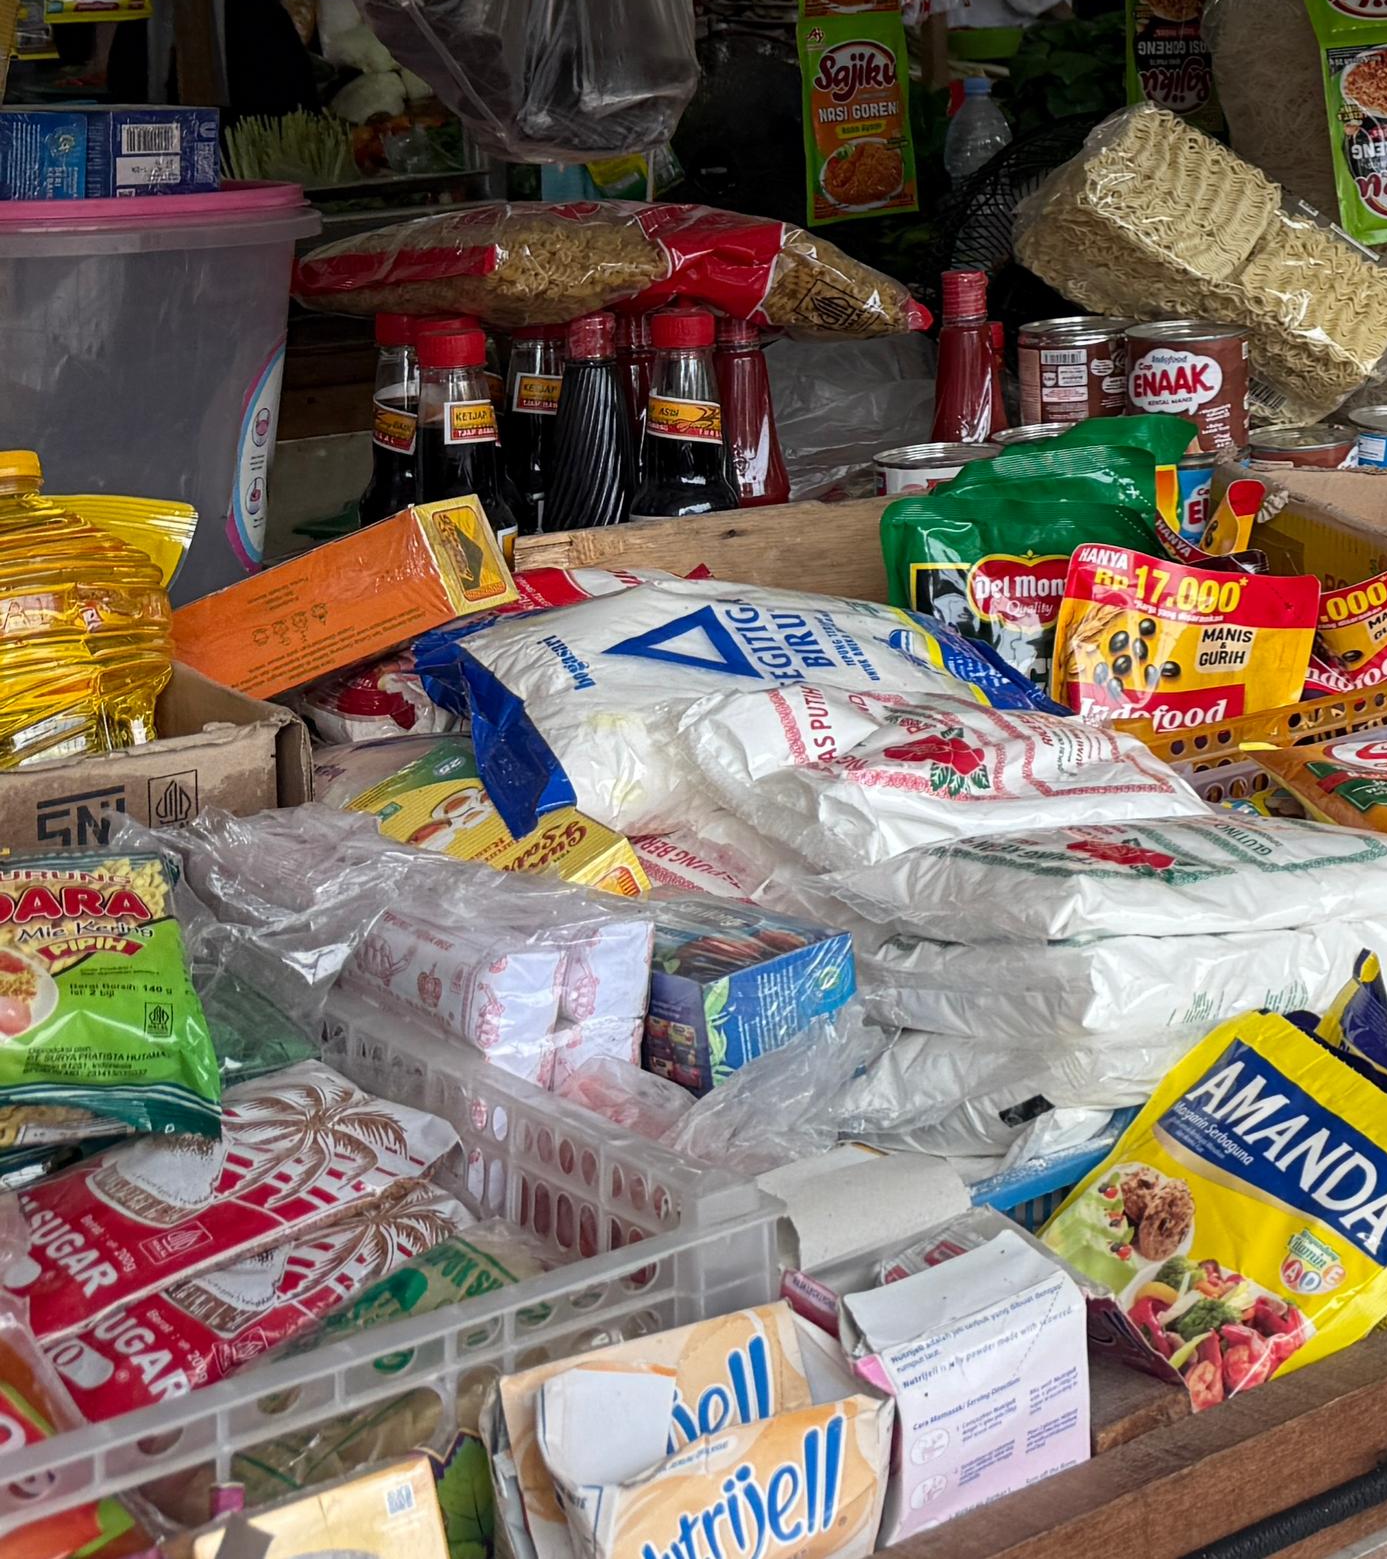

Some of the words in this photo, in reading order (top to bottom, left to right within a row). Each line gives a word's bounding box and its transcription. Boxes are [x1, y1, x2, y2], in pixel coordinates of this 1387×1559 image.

[813, 51, 898, 103] Sajiku
[818, 104, 849, 123] NASI
[1133, 362, 1214, 399] ENAAK
[455, 411, 488, 423] KETJAP
[1155, 518, 1193, 558] HANYA
[1077, 545, 1129, 571] HANYA
[974, 576, 1011, 599] Del
[1014, 574, 1067, 598] Mon
[1093, 566, 1130, 593] Rp
[1005, 599, 1054, 618] Quality
[780, 610, 836, 671] BIRU
[1201, 628, 1254, 644] MANIS
[1198, 648, 1247, 667] GURIH
[801, 685, 829, 728] PUTIH
[17, 924, 67, 941] Mie
[75, 919, 155, 939] Kering
[50, 936, 128, 956] PIPIH
[142, 983, 164, 994] 140
[1172, 1100, 1208, 1132] Margarin
[1204, 1122, 1255, 1168] Serbaguna
[29, 1206, 118, 1298] SUGAR
[1286, 1234, 1328, 1270] Vitamin
